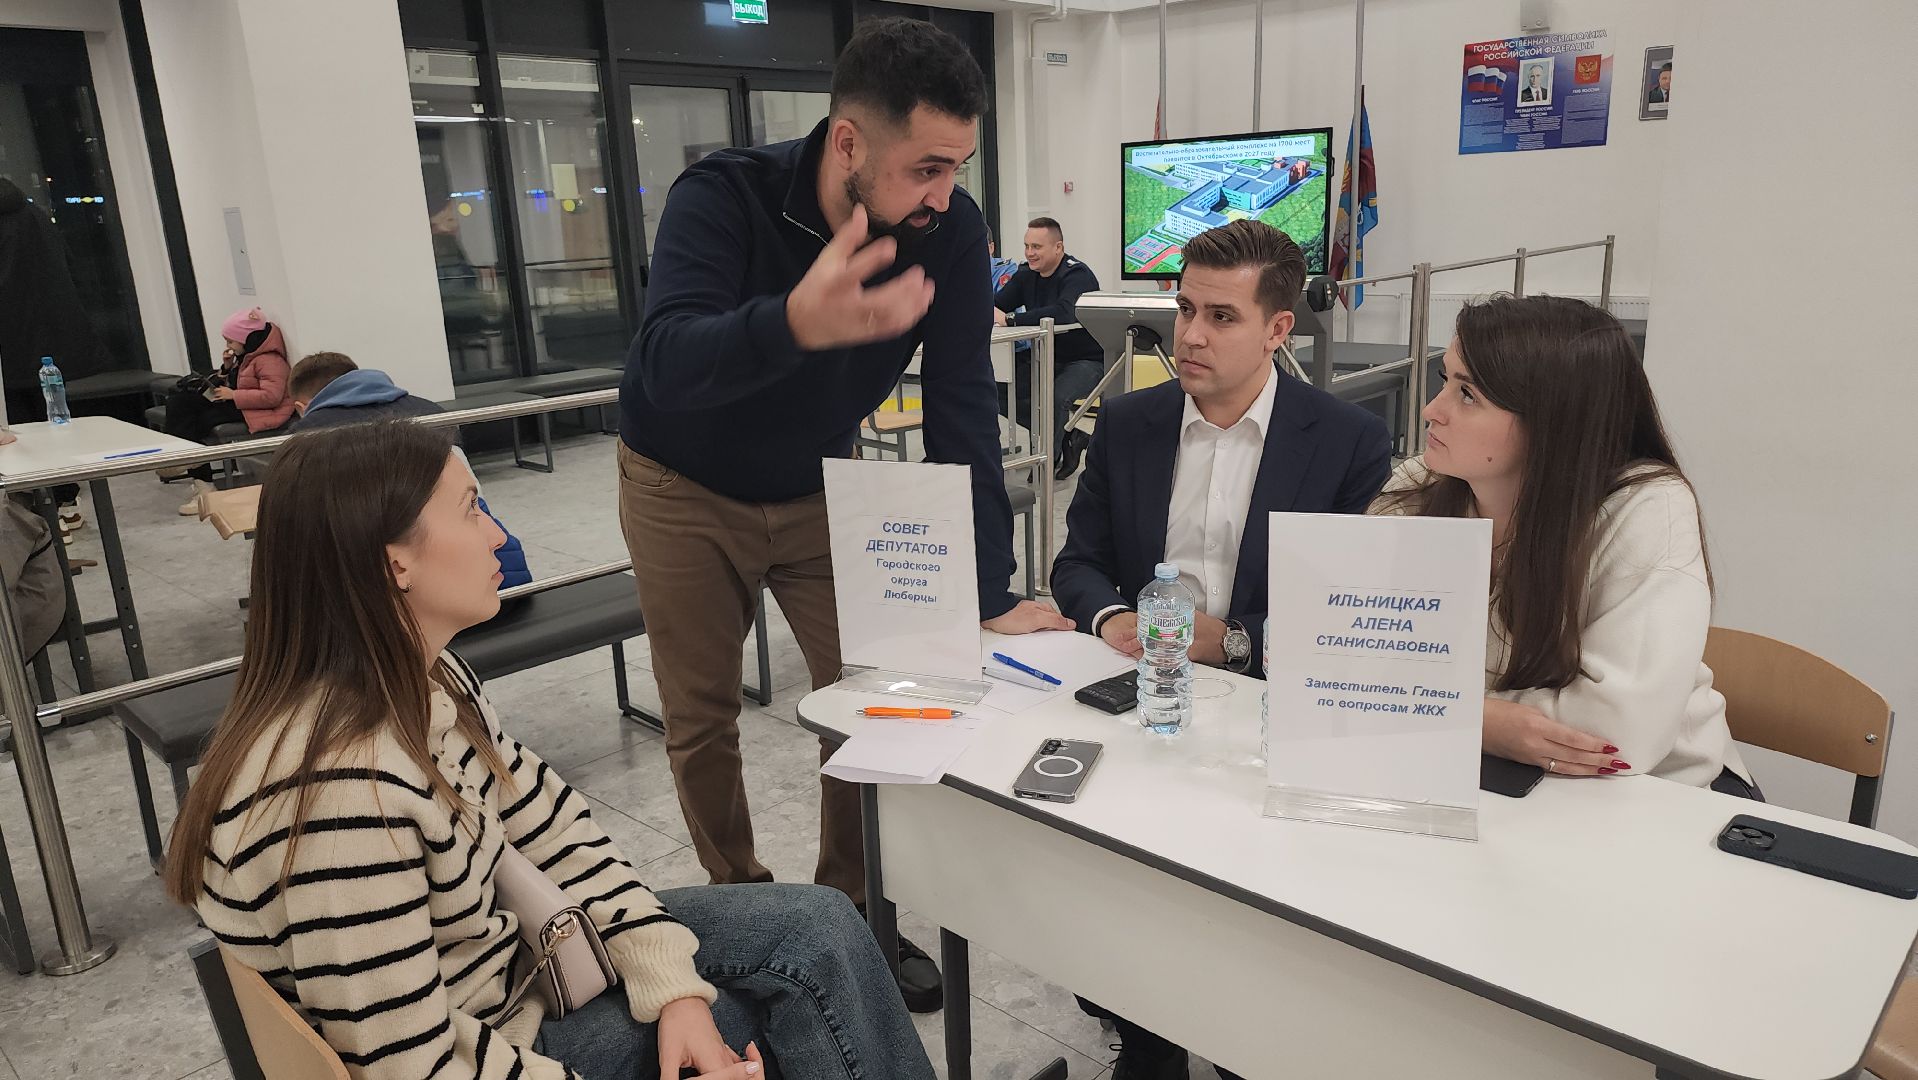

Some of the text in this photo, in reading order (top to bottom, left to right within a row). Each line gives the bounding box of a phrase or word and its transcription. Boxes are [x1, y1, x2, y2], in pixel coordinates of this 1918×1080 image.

[735, 3, 764, 17] ВЫХОД
[1473, 28, 1608, 53] ГОСУДАРСТВЕННАЯ СИМВОЛИКА
[1483, 41, 1595, 61] РОССИЙСКОЙ ФЕДЕРАЦИИ
[1236, 142, 1268, 150] комплекс
[1196, 152, 1238, 161] Октябрьском
[882, 522, 930, 535] СОВЕТ
[865, 539, 948, 555] ДЕПУТАТОВ
[876, 558, 941, 572] Городского
[890, 576, 928, 587] округа
[884, 589, 937, 603] Люберцы
[1327, 593, 1441, 612] ИЛЬНИЦКАЯ
[1351, 616, 1414, 632] АЛЕНА
[1316, 635, 1451, 654] СТАНИСЛАВОВНА
[1304, 677, 1460, 699] Заместитель Главы
[1317, 698, 1447, 717] по вопросам ЖКХ
